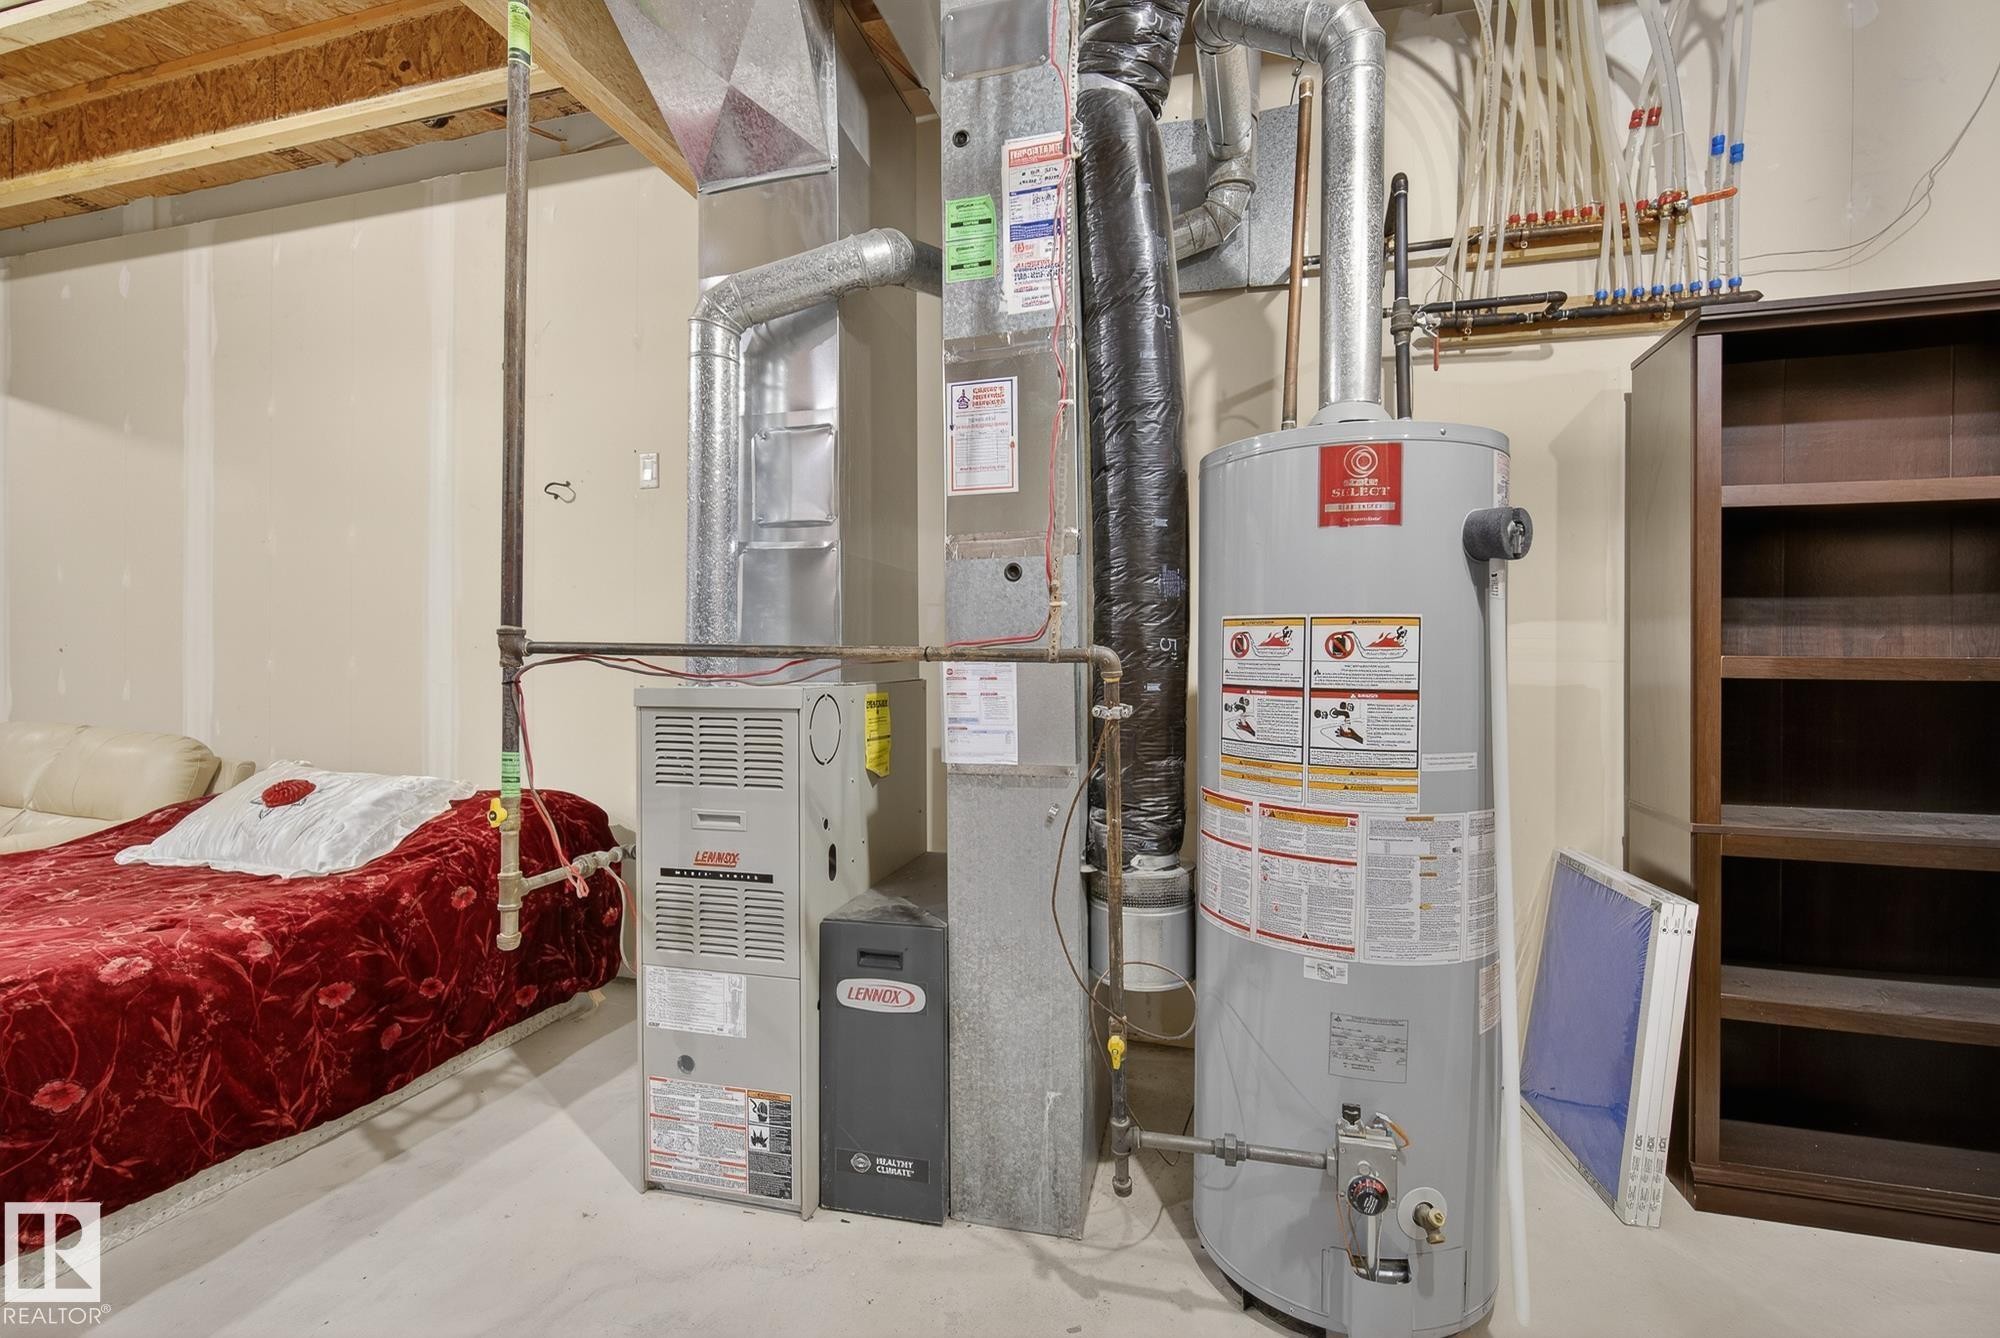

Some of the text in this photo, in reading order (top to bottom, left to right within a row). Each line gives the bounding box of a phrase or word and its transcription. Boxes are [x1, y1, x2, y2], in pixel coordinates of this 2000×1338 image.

[1331, 486, 1390, 498] SELECT
[694, 850, 740, 867] LENNOX
[847, 986, 902, 1004] LENNOX
[876, 1156, 914, 1169] HEALTHY
